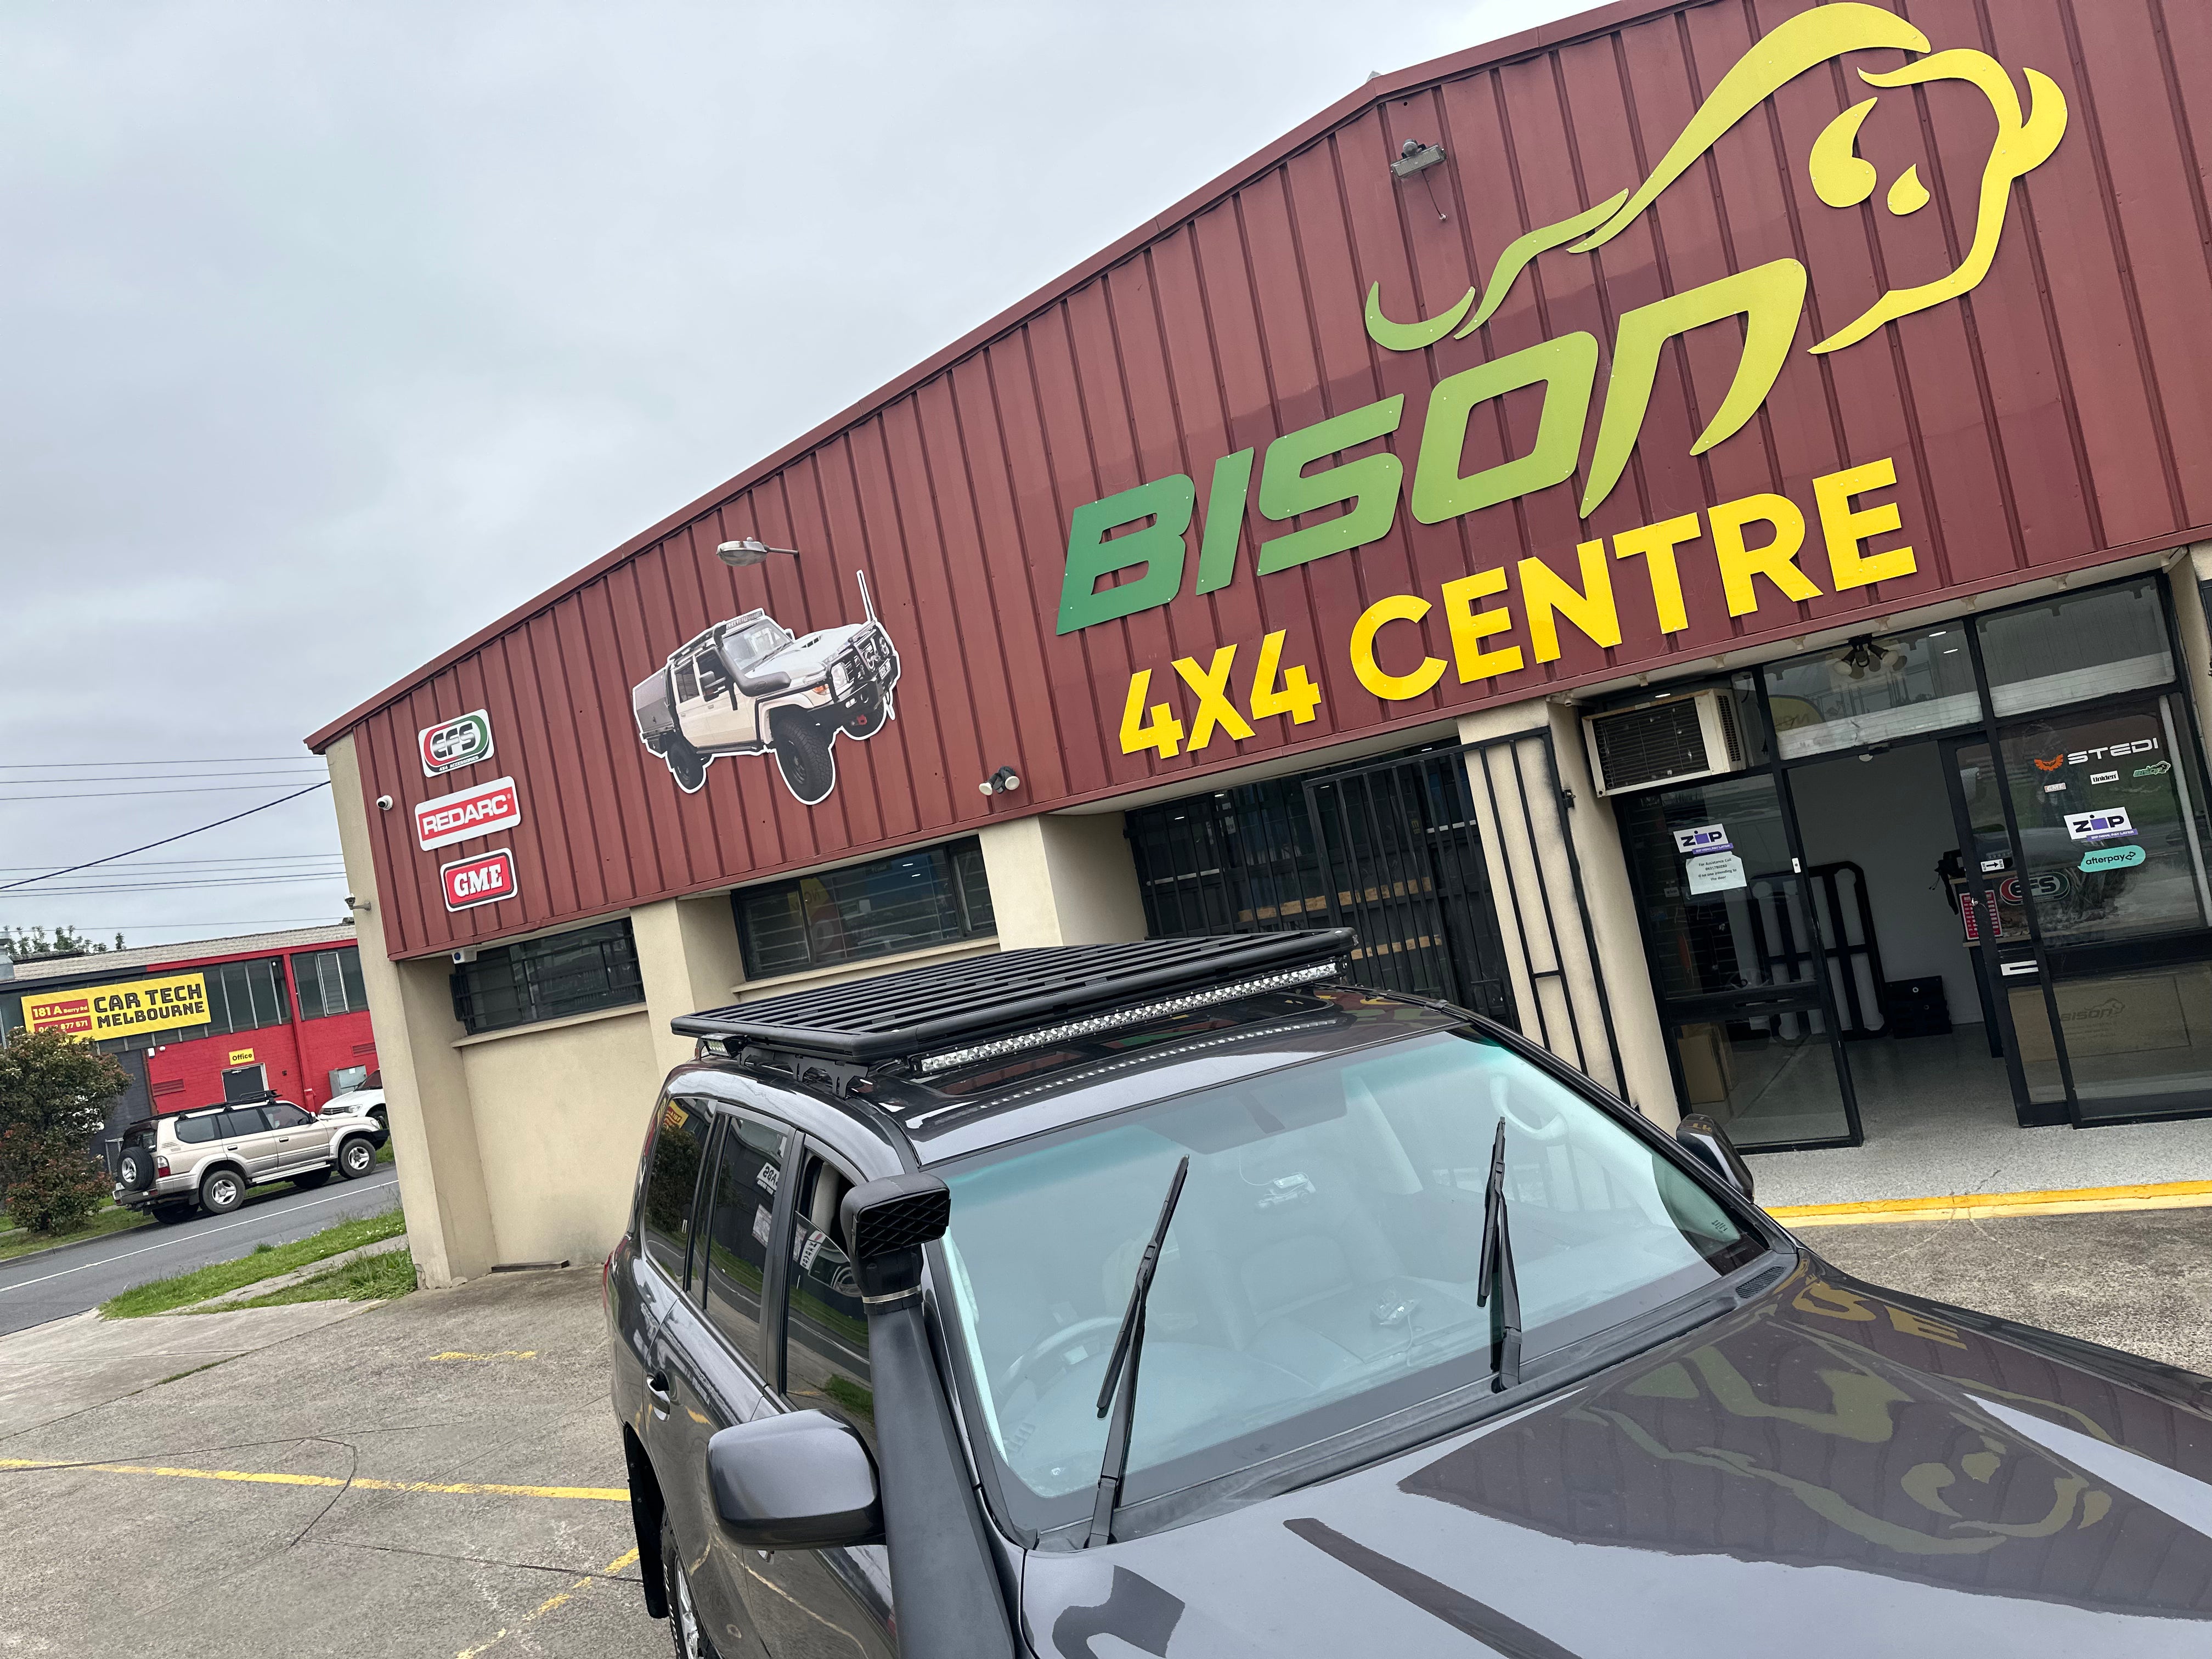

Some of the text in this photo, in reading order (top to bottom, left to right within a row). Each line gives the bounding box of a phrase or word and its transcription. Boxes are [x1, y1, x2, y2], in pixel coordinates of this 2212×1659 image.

[1056, 257, 1807, 636] BISON
[1119, 457, 1918, 760] 4X4 CENTRE
[432, 723, 476, 759] EFS
[2067, 738, 2159, 765] STEDI
[2092, 774, 2117, 782] Uniden
[422, 794, 508, 836] REDARC
[2086, 853, 2125, 865] afterpay
[454, 864, 503, 897] GME
[33, 1007, 51, 1018] 181
[53, 1005, 63, 1015] A
[94, 983, 202, 1013] CAR TECH
[97, 1001, 205, 1029] MELBOURNE
